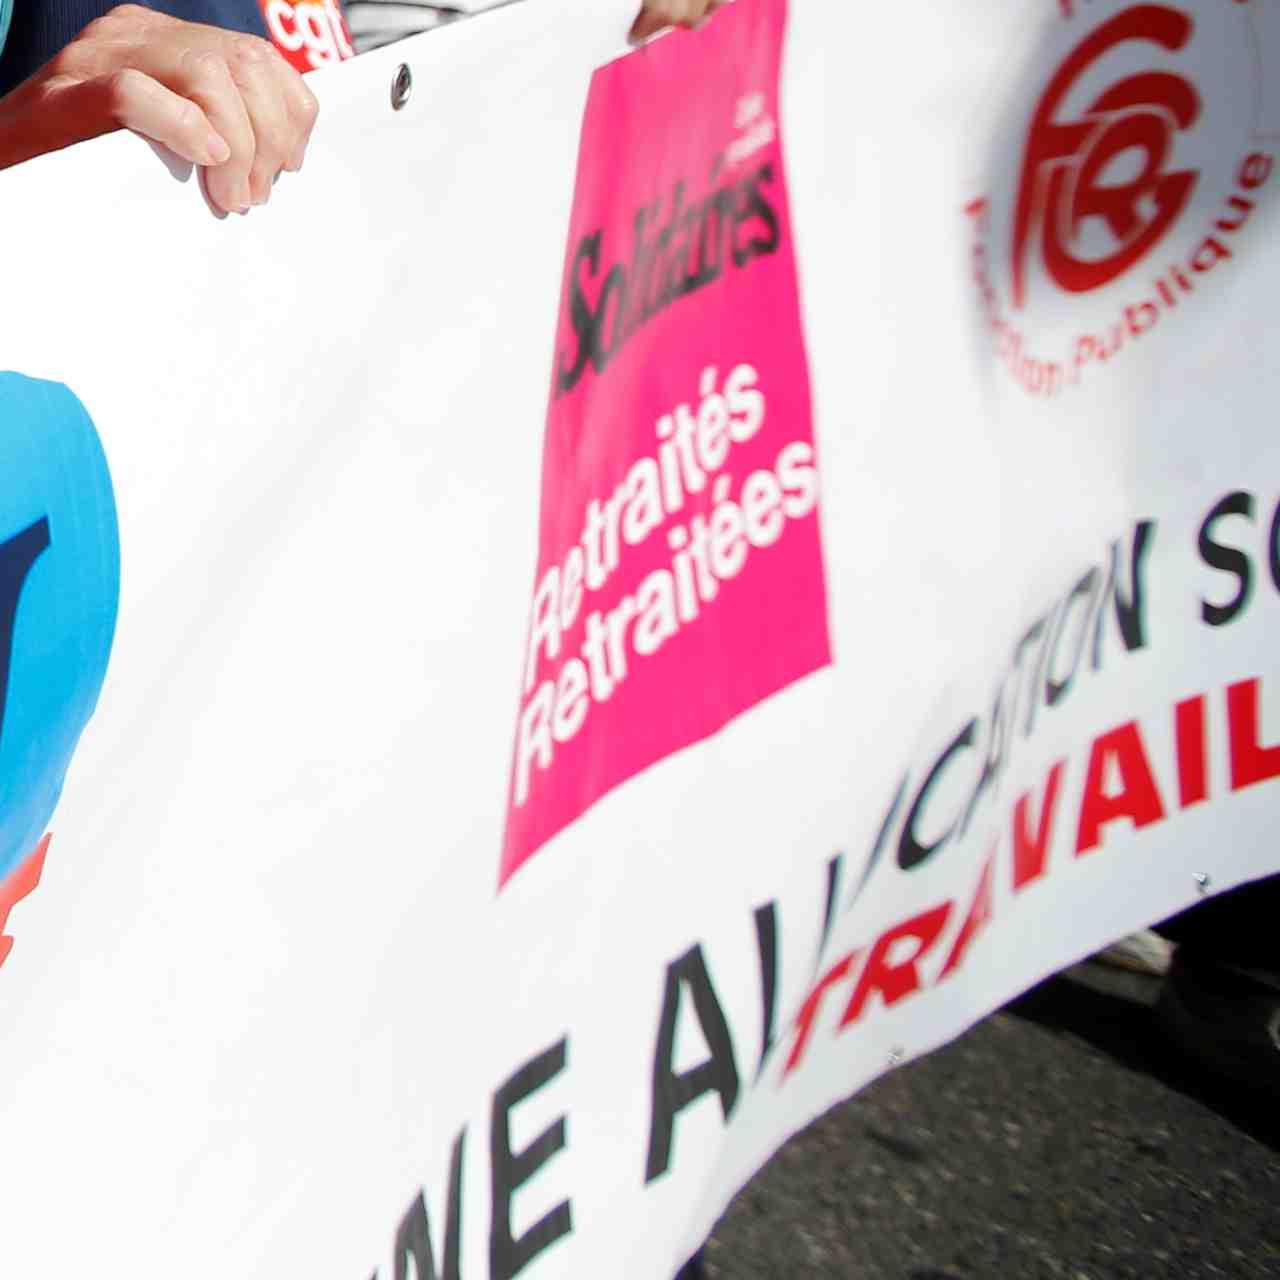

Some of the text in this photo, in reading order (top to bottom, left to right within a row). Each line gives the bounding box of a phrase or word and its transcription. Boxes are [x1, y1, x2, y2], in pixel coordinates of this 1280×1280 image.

[512, 441, 817, 808] Retraitées
[525, 363, 766, 698] Retraités
[778, 675, 1280, 1090] TRAVAIL
